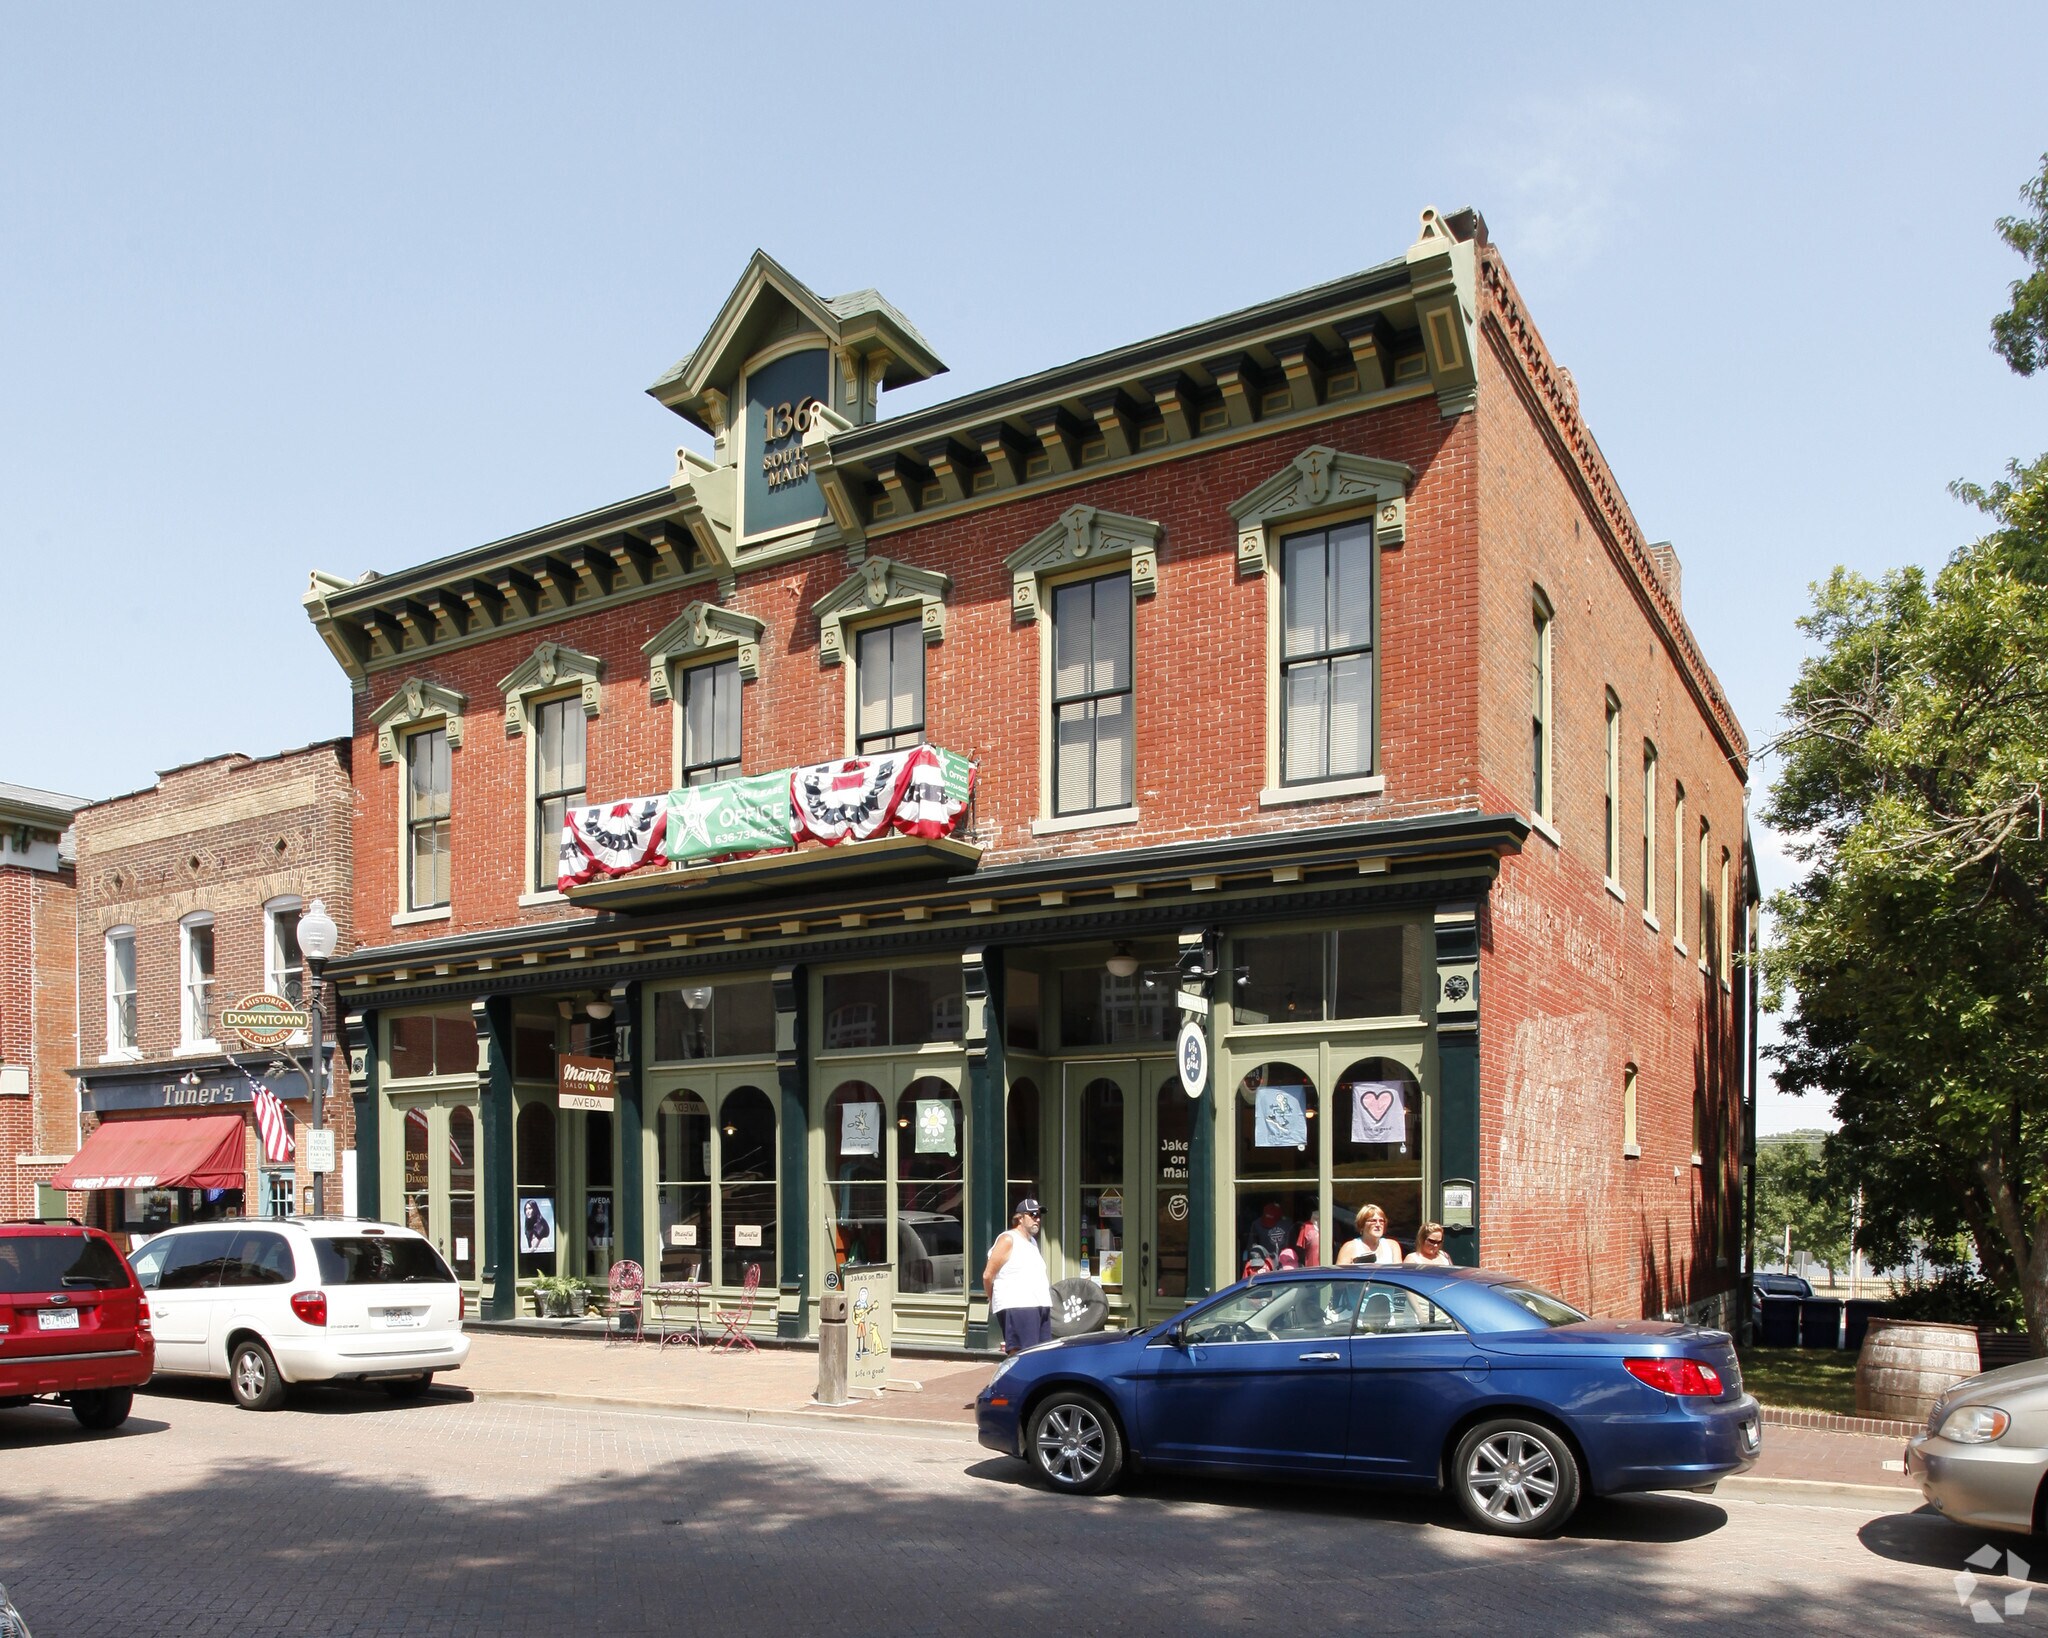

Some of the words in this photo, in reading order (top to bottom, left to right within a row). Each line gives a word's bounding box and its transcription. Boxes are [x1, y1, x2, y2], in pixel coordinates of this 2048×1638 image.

[764, 396, 811, 442] 136
[763, 447, 809, 470] SOUT
[768, 462, 809, 487] MAIN
[733, 791, 751, 801] FOR
[753, 785, 784, 798] LEASE
[719, 802, 784, 827] OFFICE
[245, 996, 286, 1009] HISTORIC
[227, 1013, 303, 1025] DOWNTOWN
[253, 1030, 289, 1043] CHARLES
[563, 1063, 613, 1084] Mantra
[565, 1082, 588, 1090] SALON
[163, 1084, 235, 1106] Tuner's
[572, 1097, 602, 1108] AVEDA
[406, 1150, 428, 1161] Evans
[1170, 1155, 1186, 1164] on
[413, 1161, 420, 1172] &
[406, 1172, 428, 1183] Dixon
[850, 1273, 867, 1282] Jake's
[855, 1368, 865, 1378] Life
